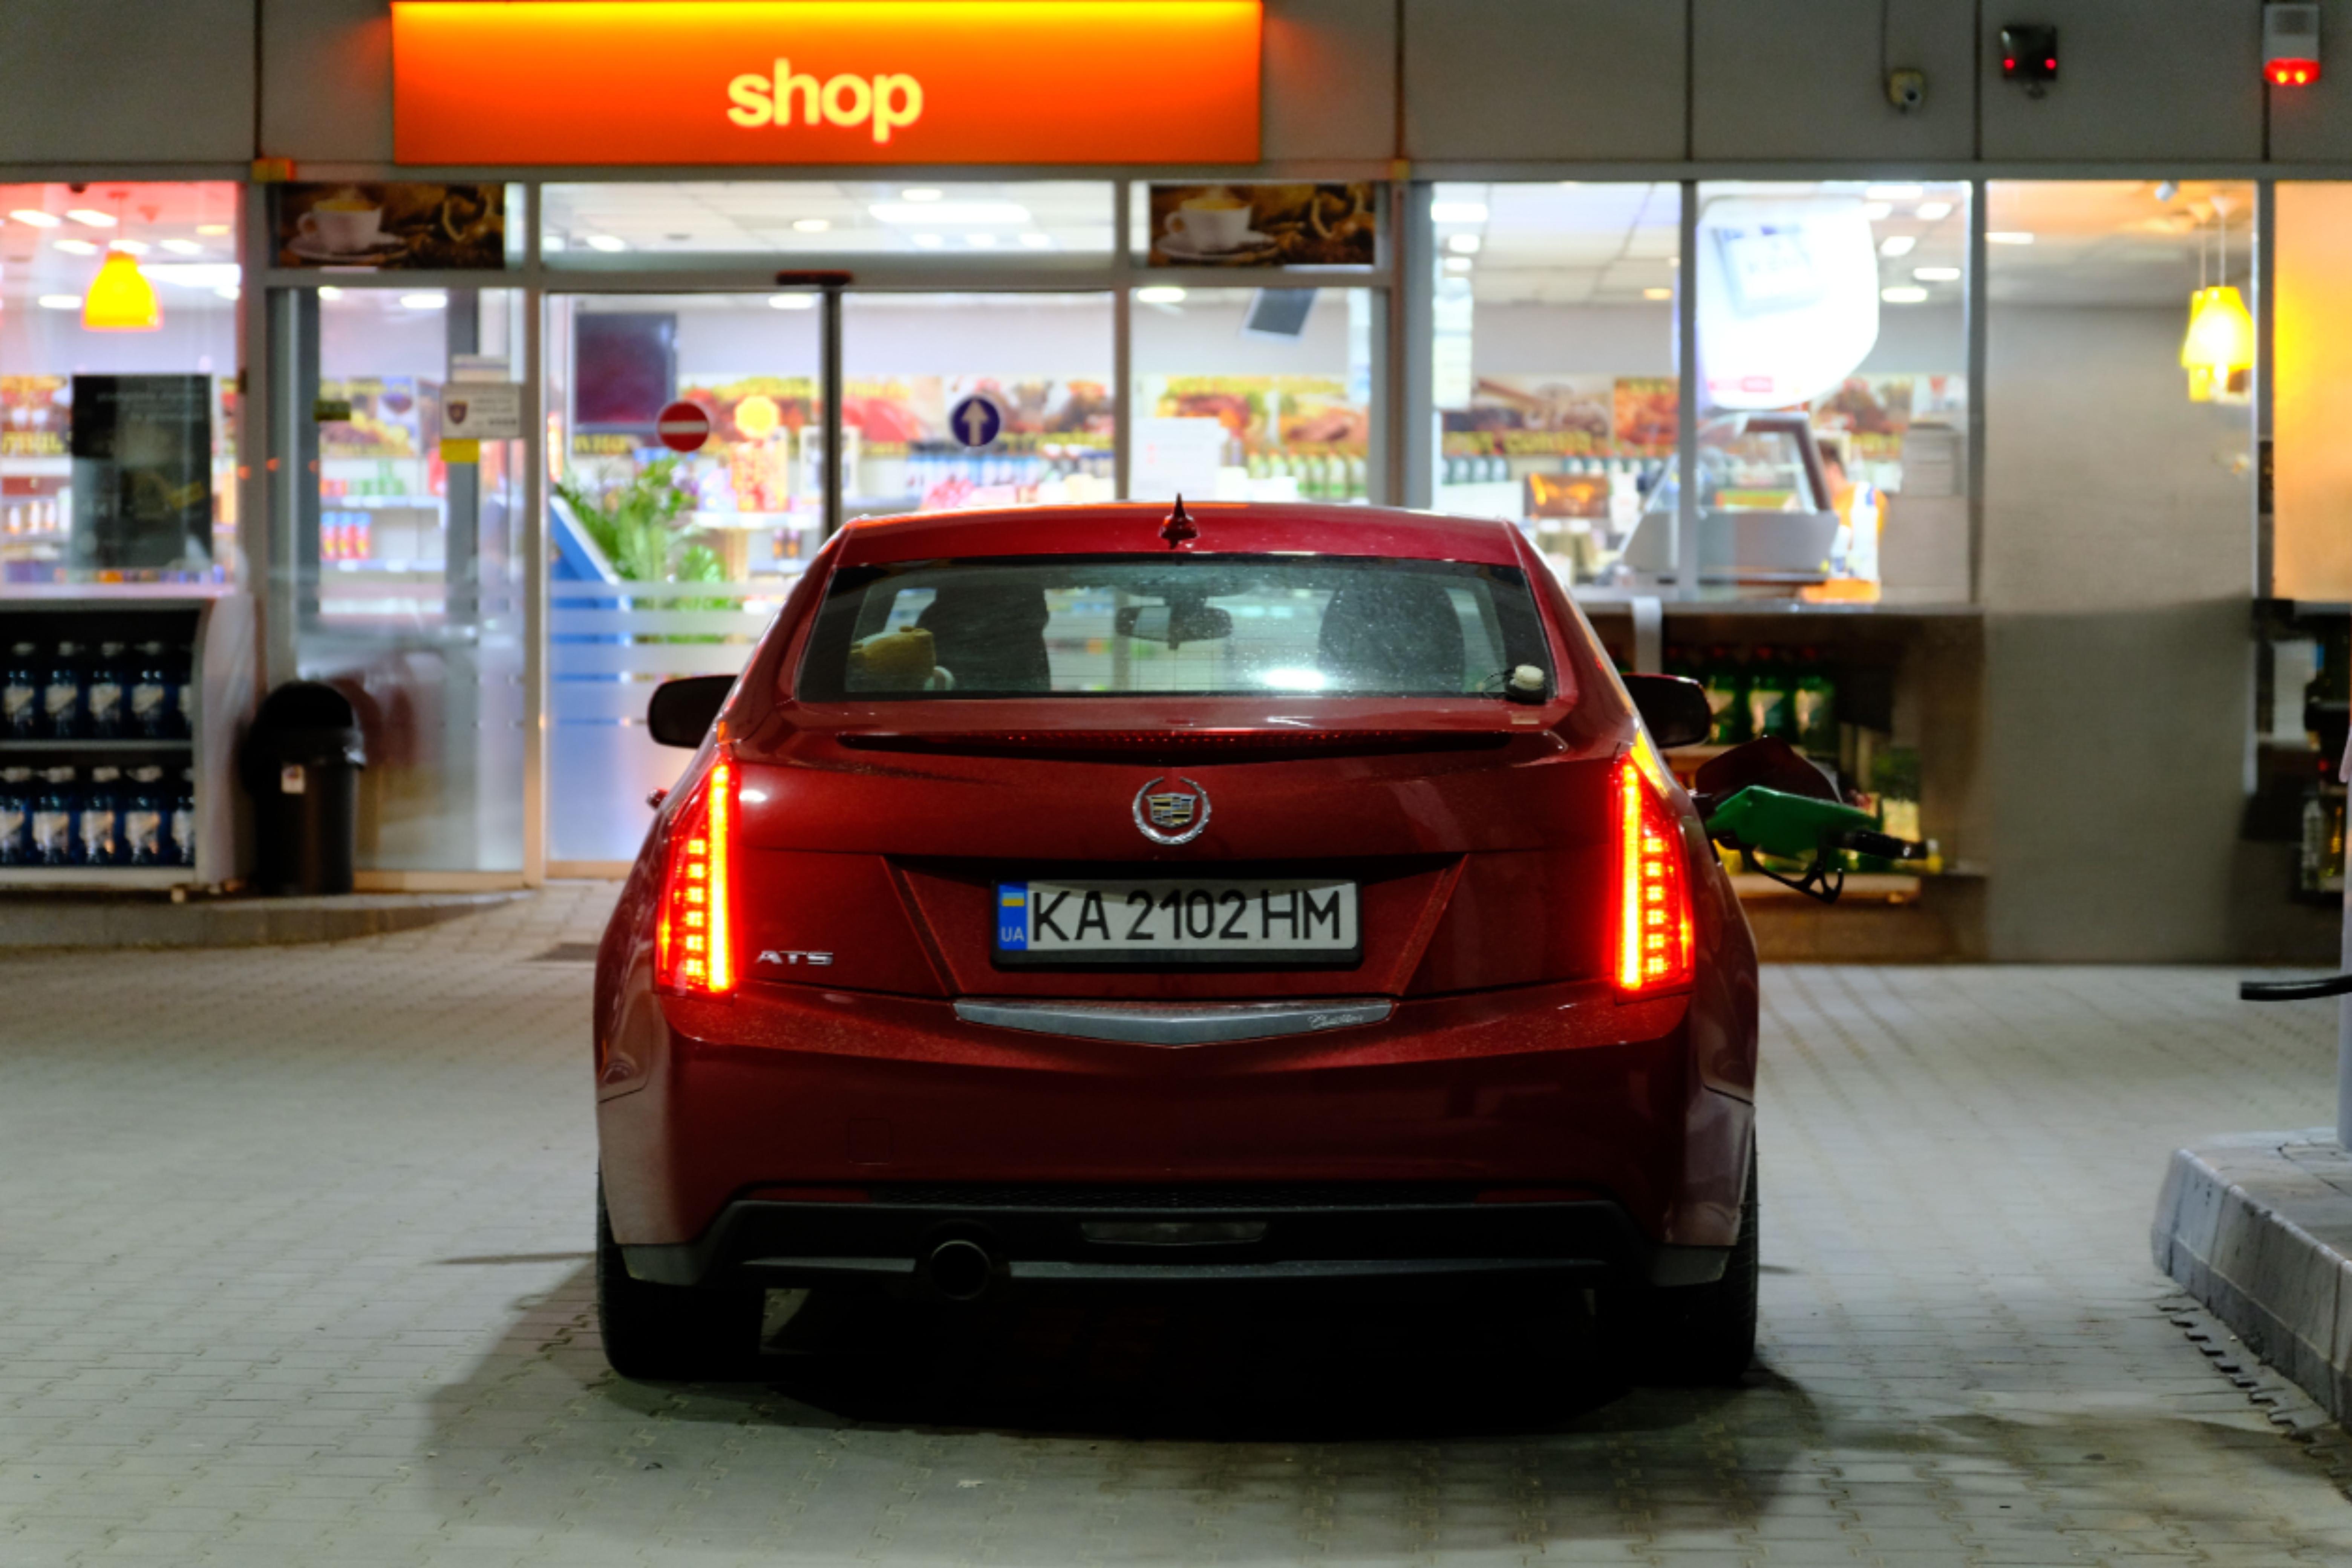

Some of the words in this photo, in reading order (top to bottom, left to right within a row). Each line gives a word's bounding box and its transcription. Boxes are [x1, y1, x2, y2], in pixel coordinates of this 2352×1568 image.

[727, 57, 923, 144] shop
[1033, 891, 1111, 941] KA
[1125, 890, 1248, 940] 2102
[1262, 890, 1340, 939] HM
[1001, 926, 1025, 942] UA
[755, 950, 834, 965] ATS
